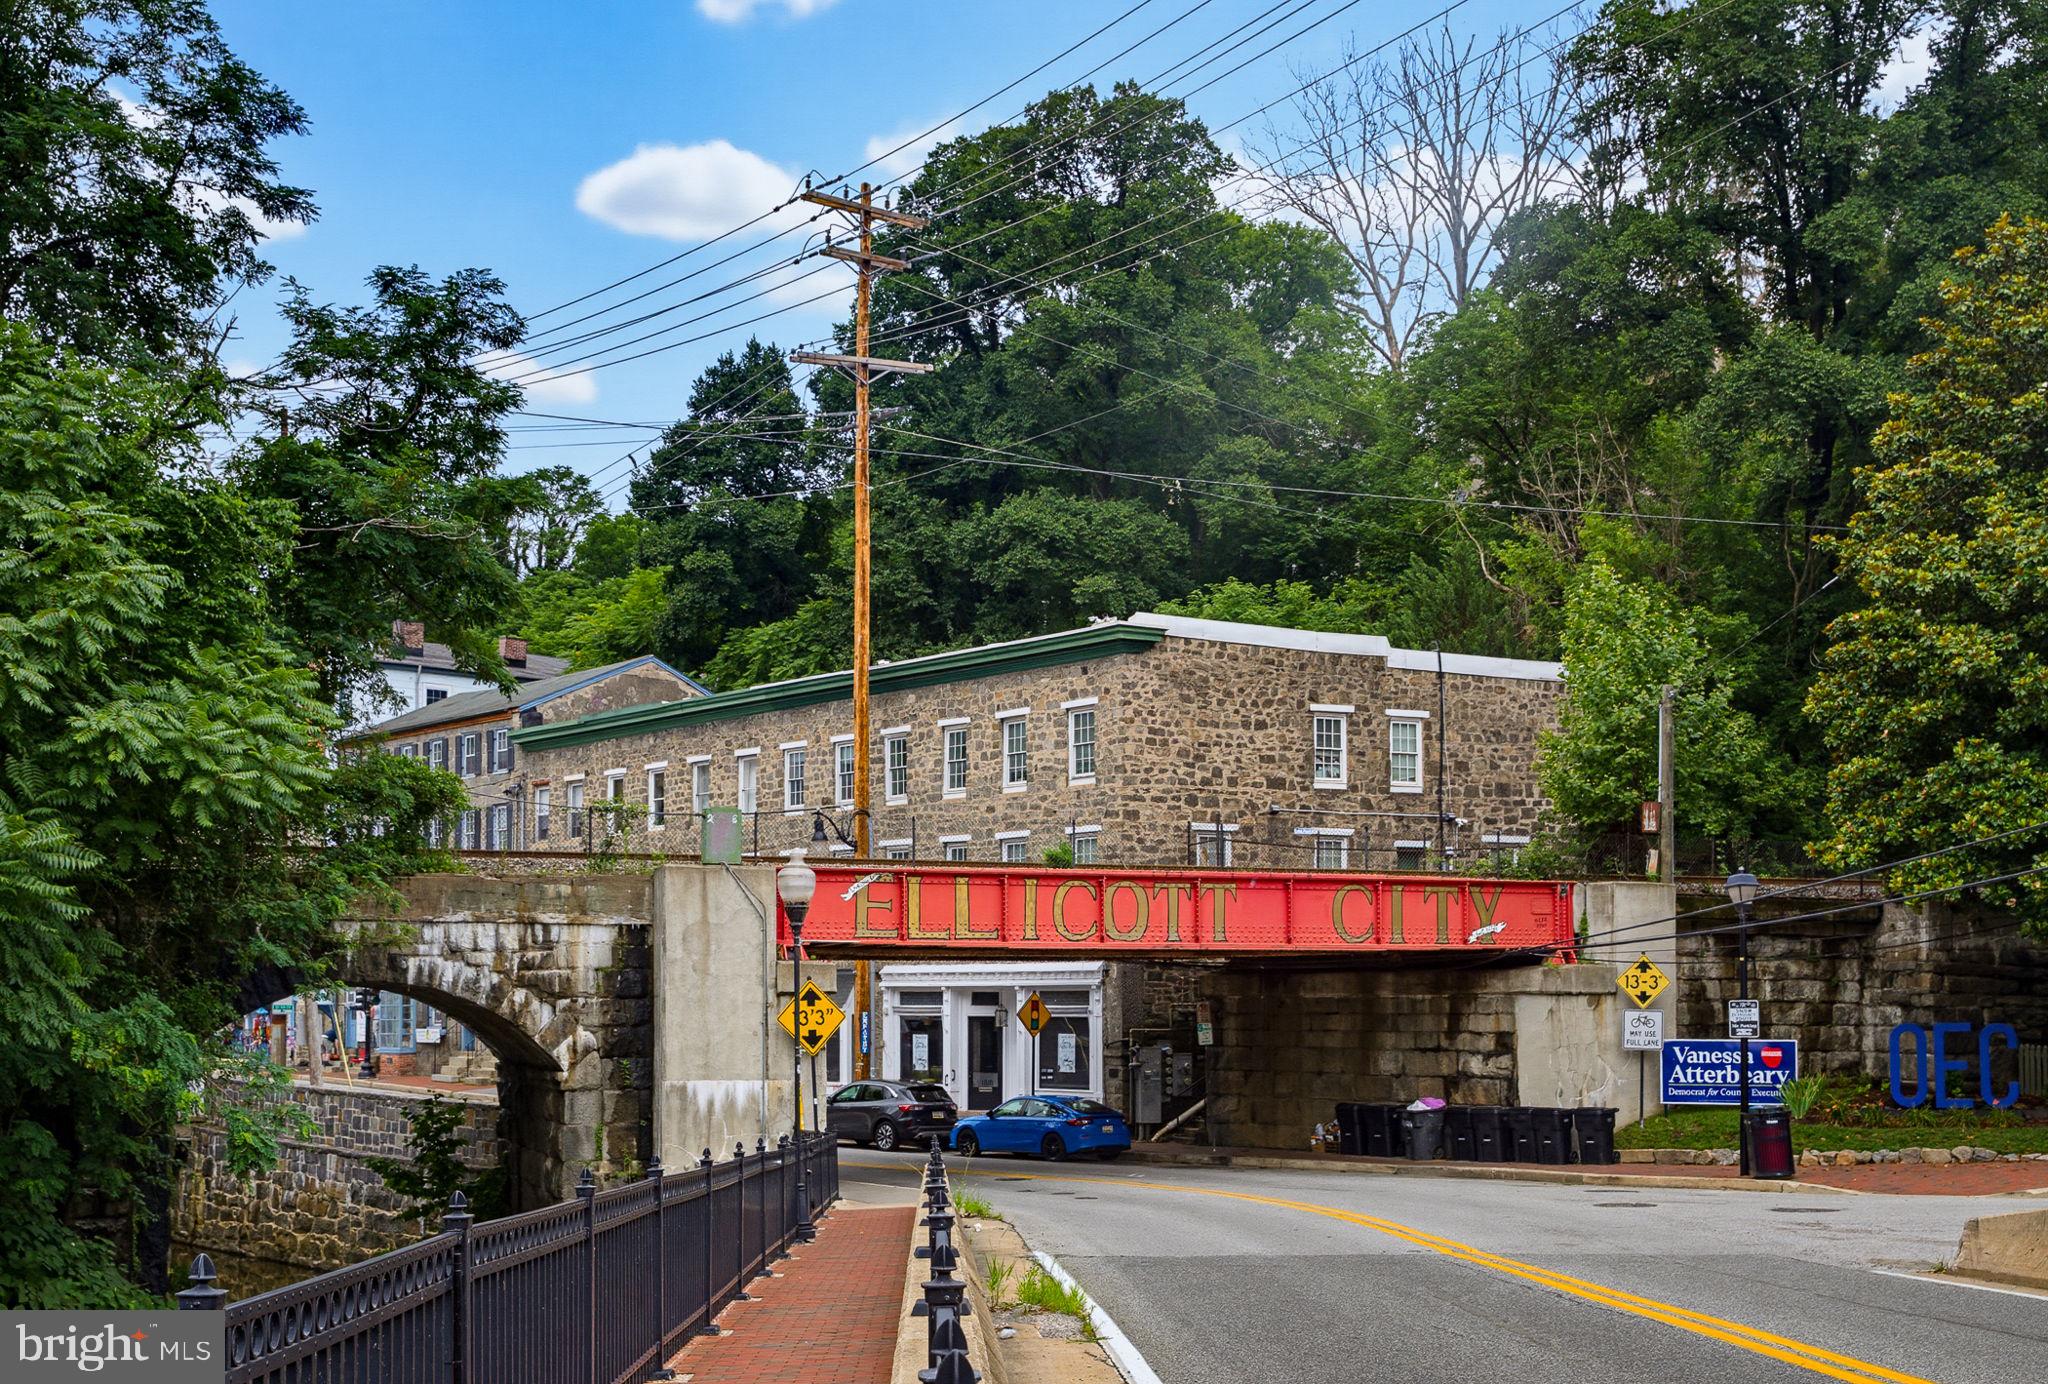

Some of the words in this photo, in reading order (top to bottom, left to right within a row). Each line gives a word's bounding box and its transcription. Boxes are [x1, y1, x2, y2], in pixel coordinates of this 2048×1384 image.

[853, 875, 1237, 942] ELLICOTT
[1332, 884, 1503, 944] CITY
[792, 1008, 834, 1026] 3'3"
[1889, 1023, 2020, 1109] OEC
[1668, 1087, 1706, 1096] Democrat
[1706, 1087, 1720, 1098] for
[1720, 1087, 1742, 1097] Coun
